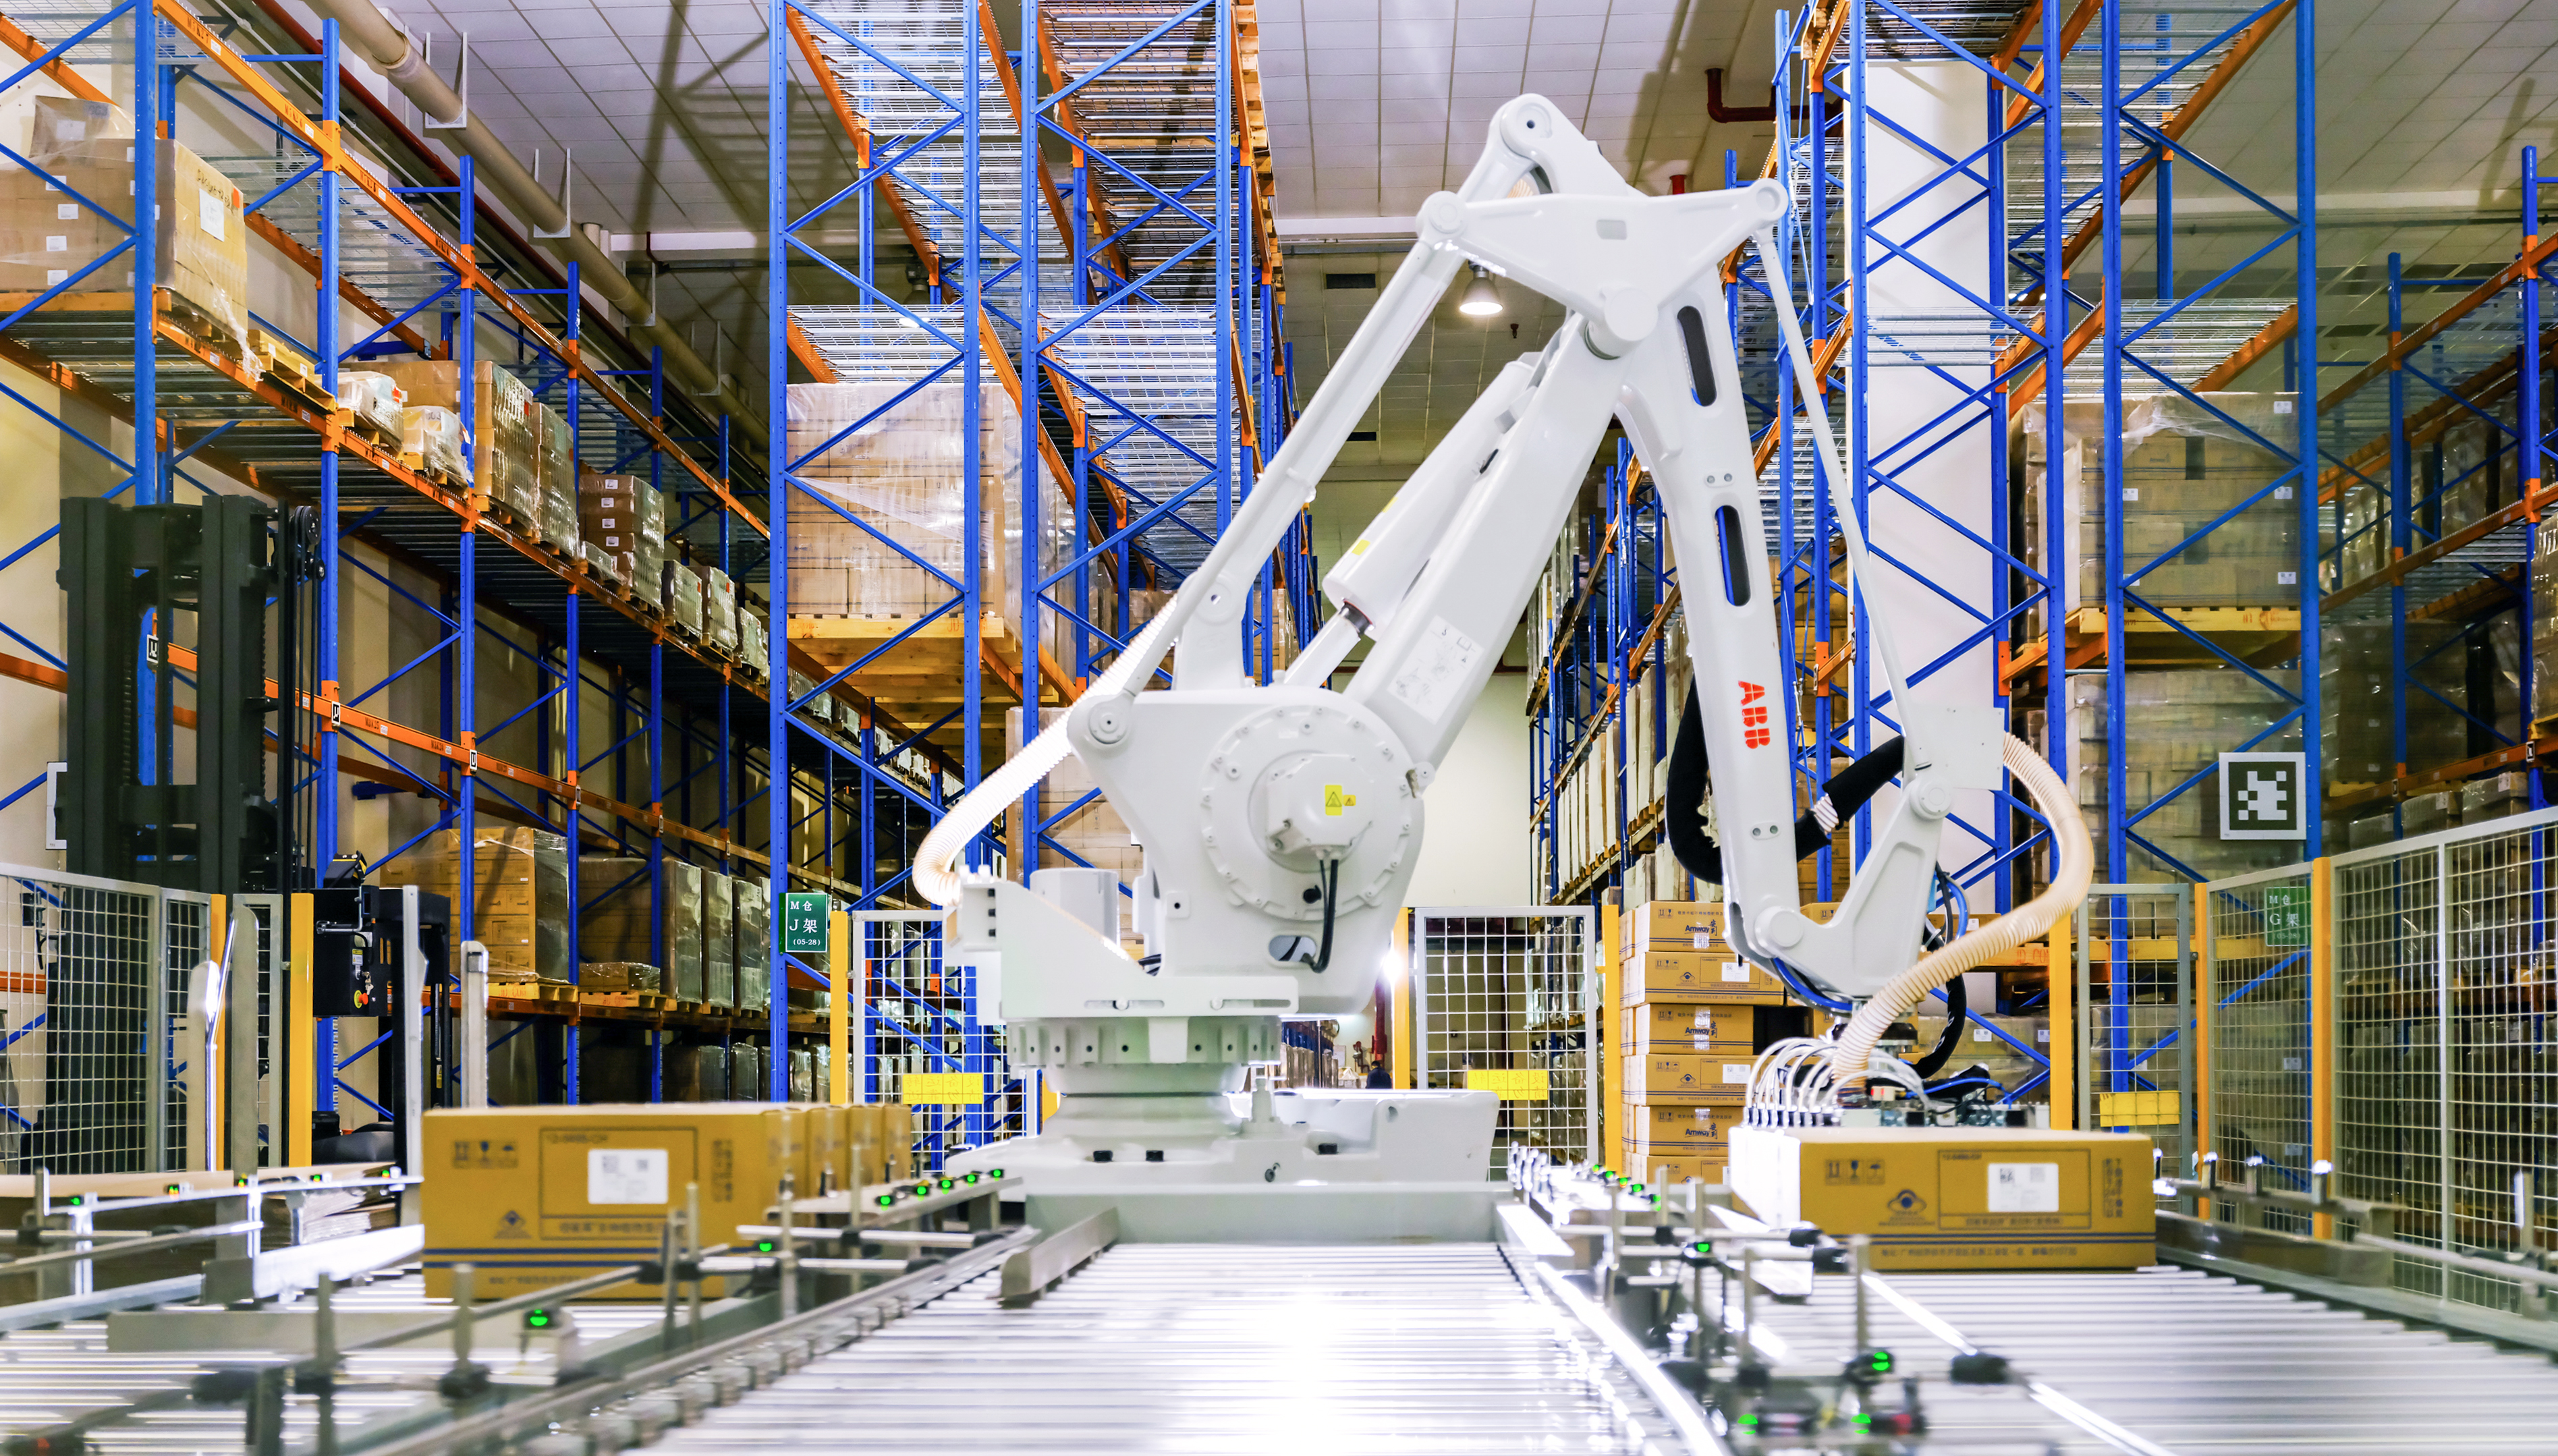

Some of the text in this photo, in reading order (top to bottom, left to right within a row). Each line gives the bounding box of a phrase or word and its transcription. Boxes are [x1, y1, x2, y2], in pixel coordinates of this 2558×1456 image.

[1737, 680, 1771, 750] ABB
[2269, 895, 2291, 905] M 仓
[790, 901, 812, 912] M 仓
[2269, 912, 2300, 927] G 架
[789, 918, 818, 934] J 架
[1685, 925, 1710, 933] Amway
[1685, 1027, 1710, 1035] Amway
[1685, 1129, 1710, 1137] Amway
